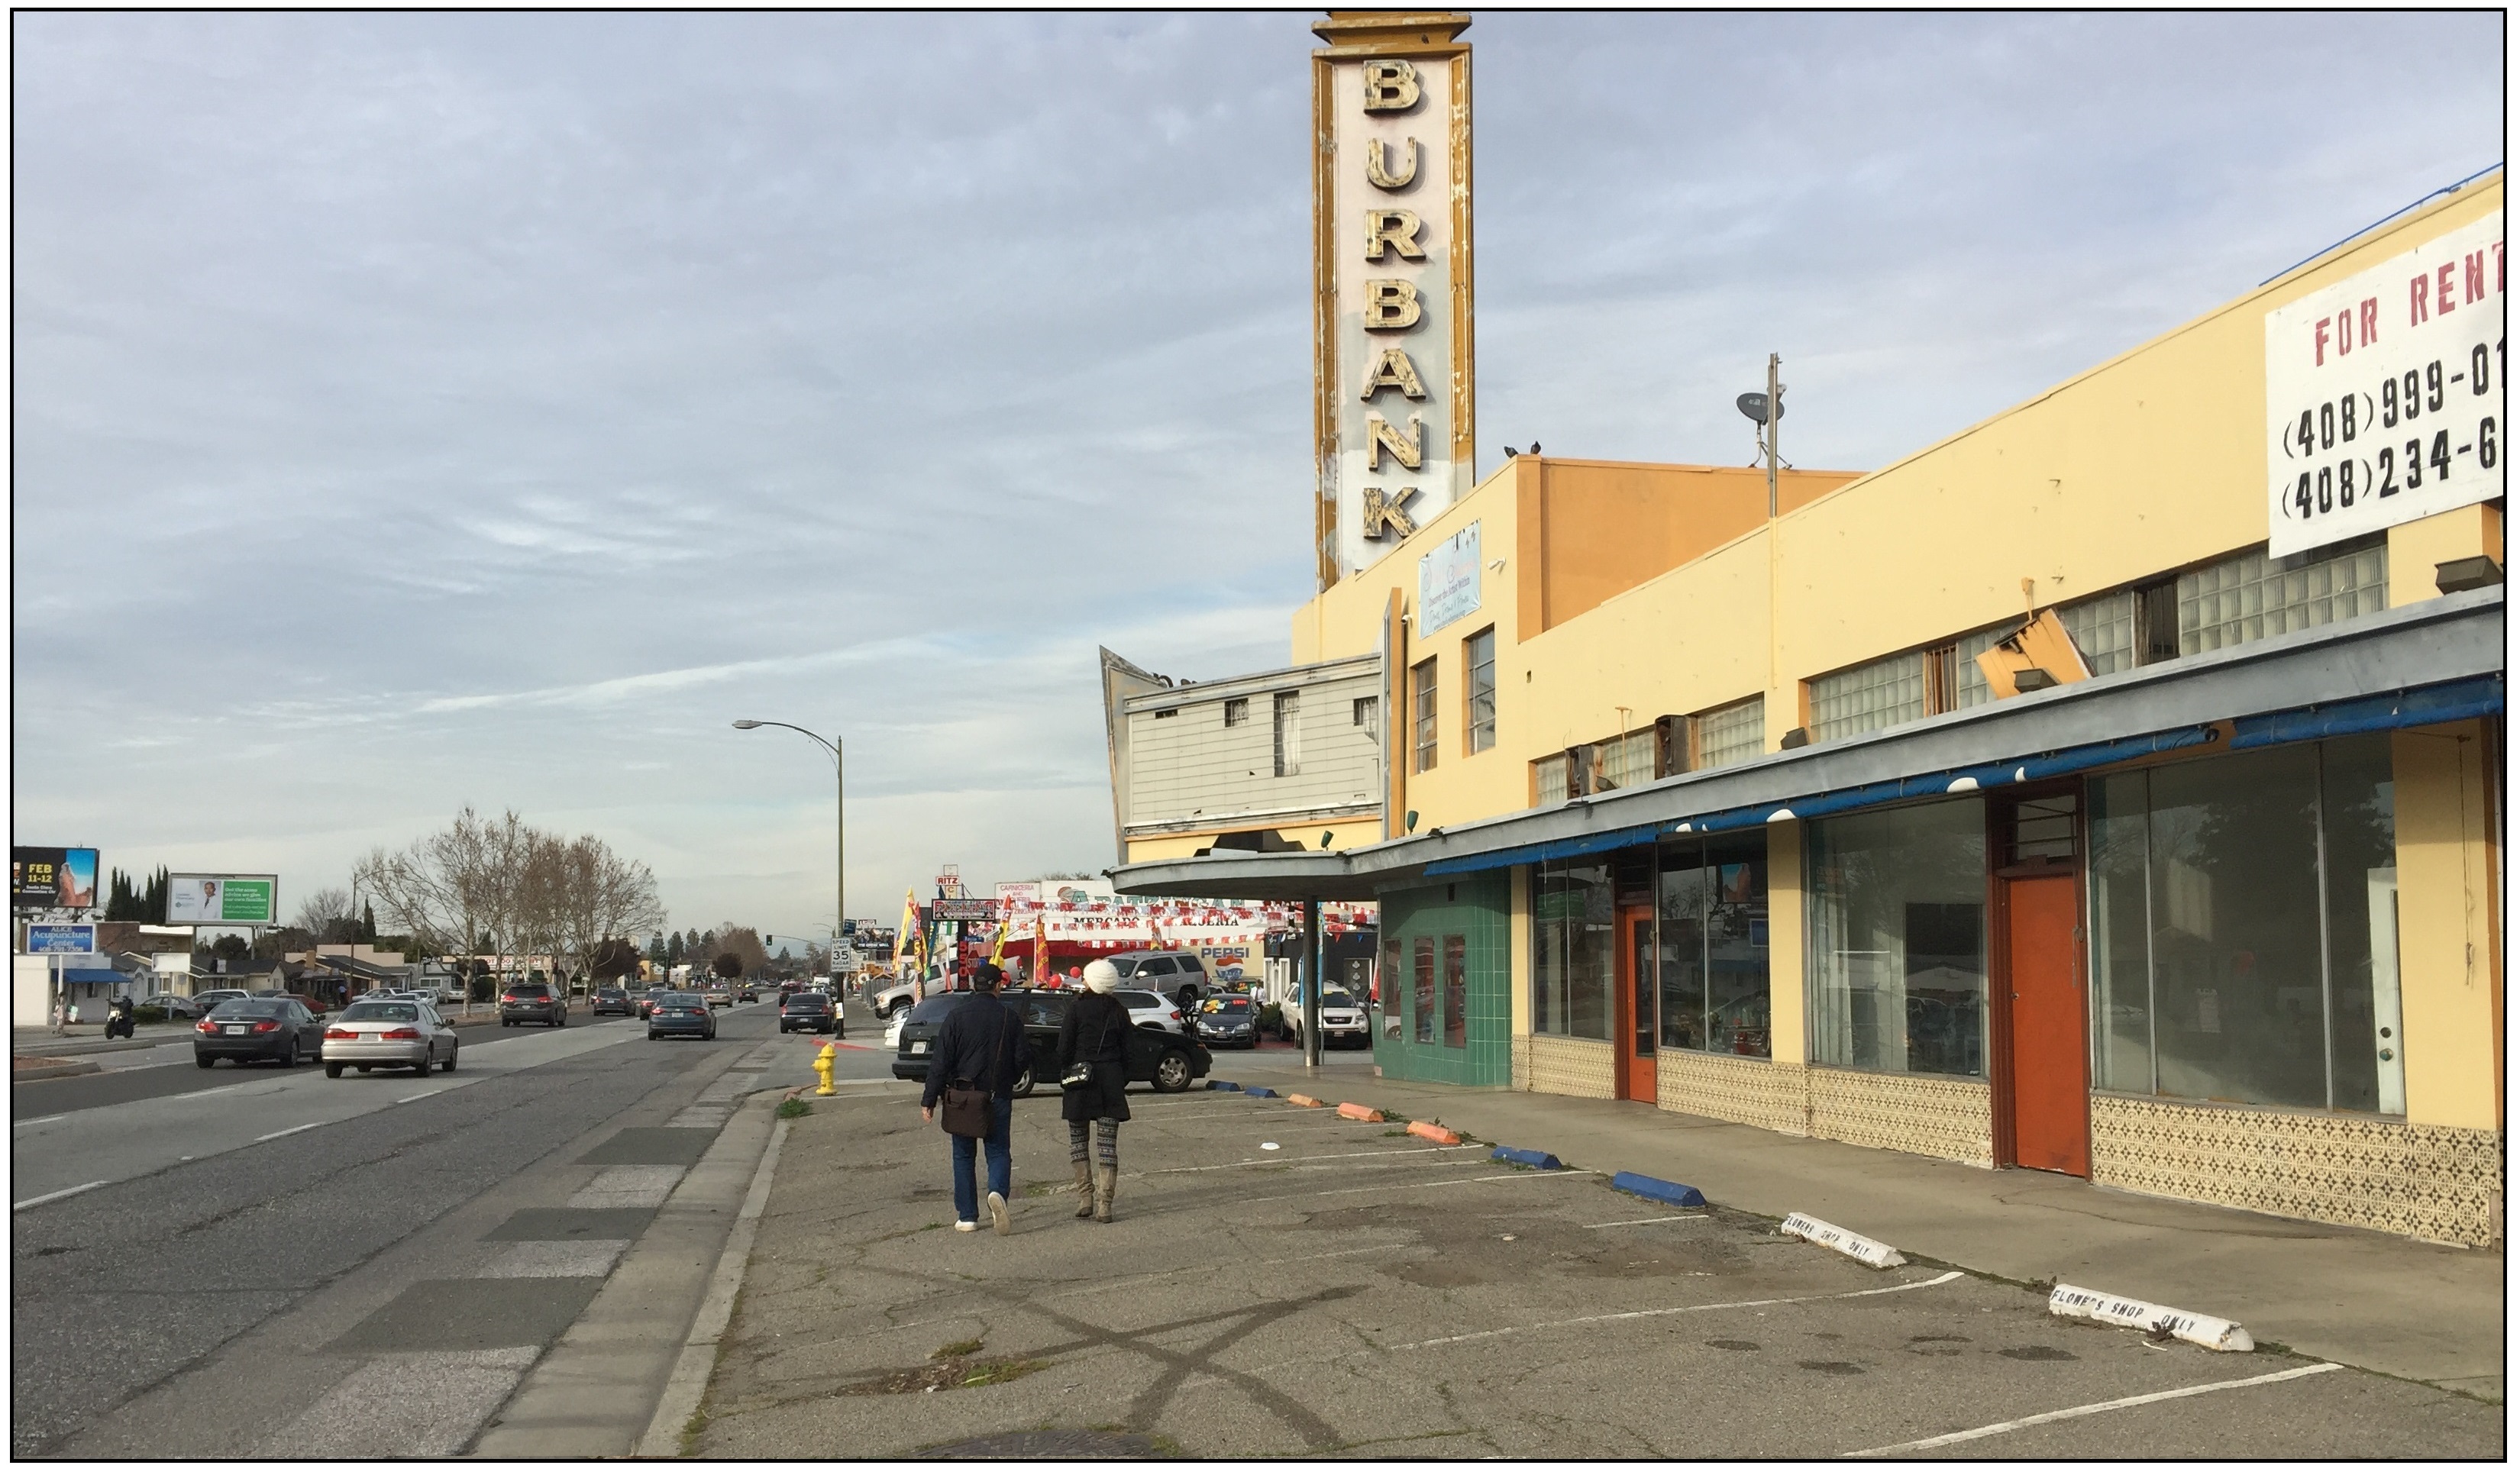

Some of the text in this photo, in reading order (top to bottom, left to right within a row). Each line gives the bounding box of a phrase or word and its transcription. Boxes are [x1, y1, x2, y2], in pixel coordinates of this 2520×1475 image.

[1361, 59, 1426, 537] BURBANK
[2315, 240, 2503, 367] FOR RENT
[2283, 416, 2496, 519] (408)234-6
[29, 864, 52, 873] FEB
[32, 931, 90, 939] Acupuncture
[833, 951, 848, 960] 35
[1201, 947, 1249, 958] PEPSI
[1061, 1076, 1078, 1084] adidas
[1849, 1241, 1870, 1256] ONLY
[2051, 1289, 2195, 1332] FLOWES SHOP ONLY
